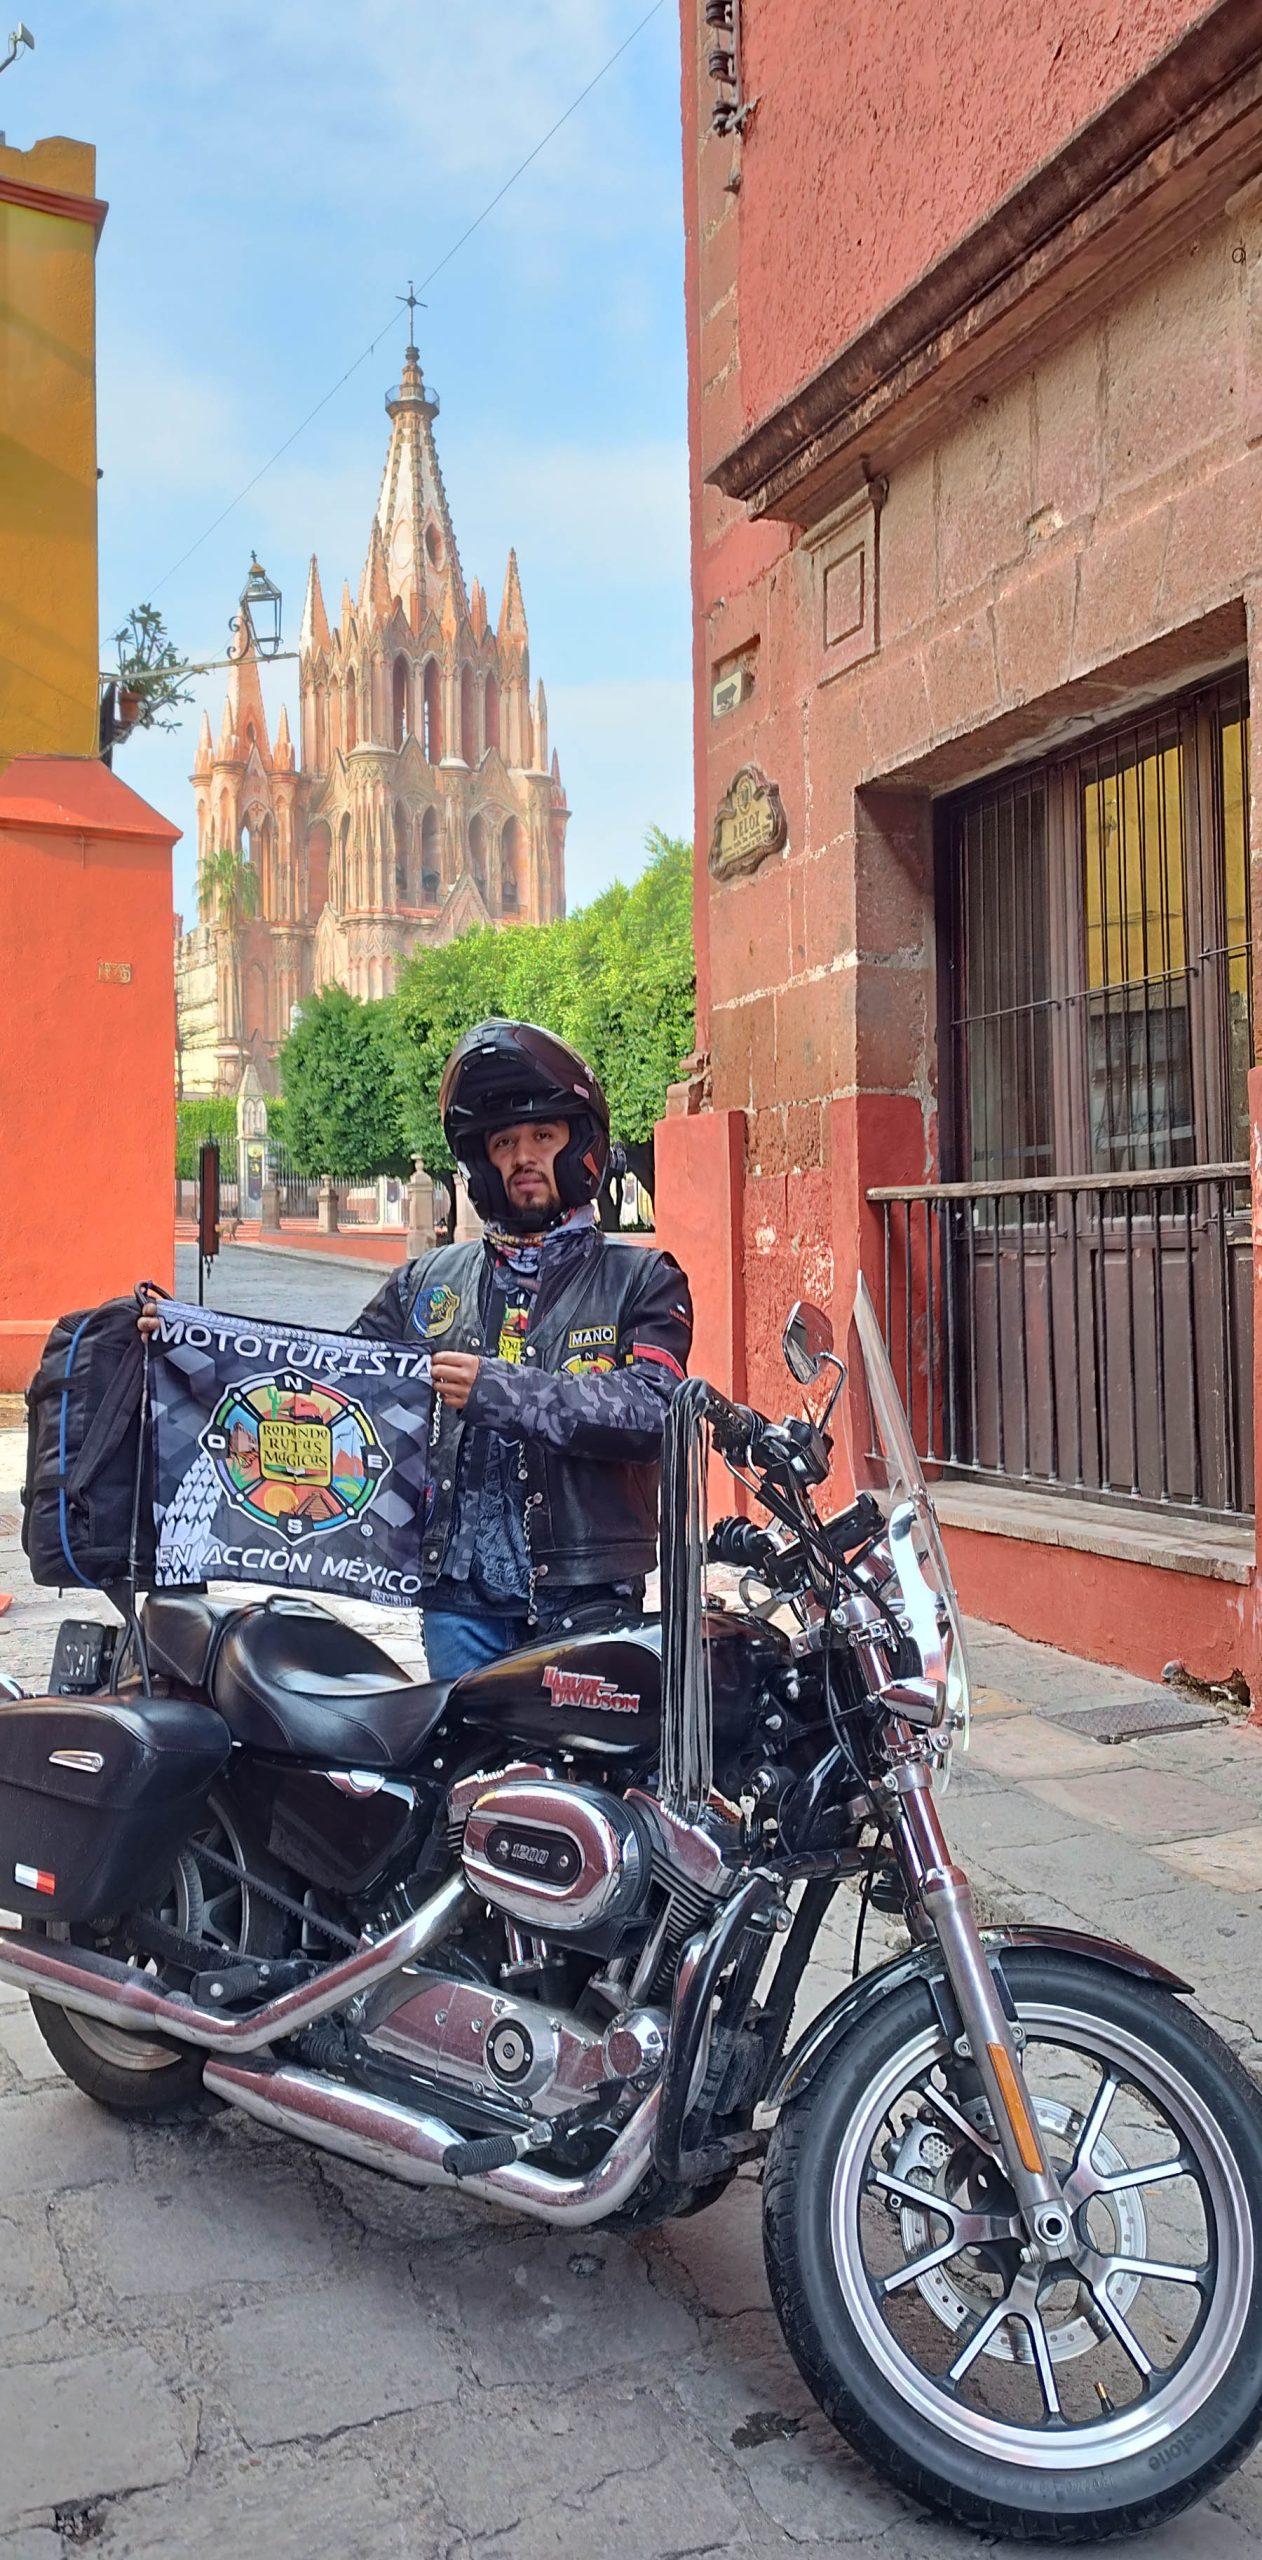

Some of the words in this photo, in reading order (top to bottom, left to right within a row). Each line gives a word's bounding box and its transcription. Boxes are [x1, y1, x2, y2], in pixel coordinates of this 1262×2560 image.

[572, 1327, 614, 1346] MANO
[151, 1316, 433, 1379] MOTOTURISTA
[585, 1352, 595, 1362] N
[283, 1375, 303, 1391] N
[207, 1433, 226, 1449] O
[366, 1454, 383, 1470] E
[286, 1517, 304, 1534] S
[156, 1545, 192, 1567] EN
[202, 1545, 314, 1576] ACCIÓN
[321, 1555, 423, 1595] MÉXICO
[550, 1686, 641, 1715] DAVIDSON
[510, 1842, 550, 1866] 1200
